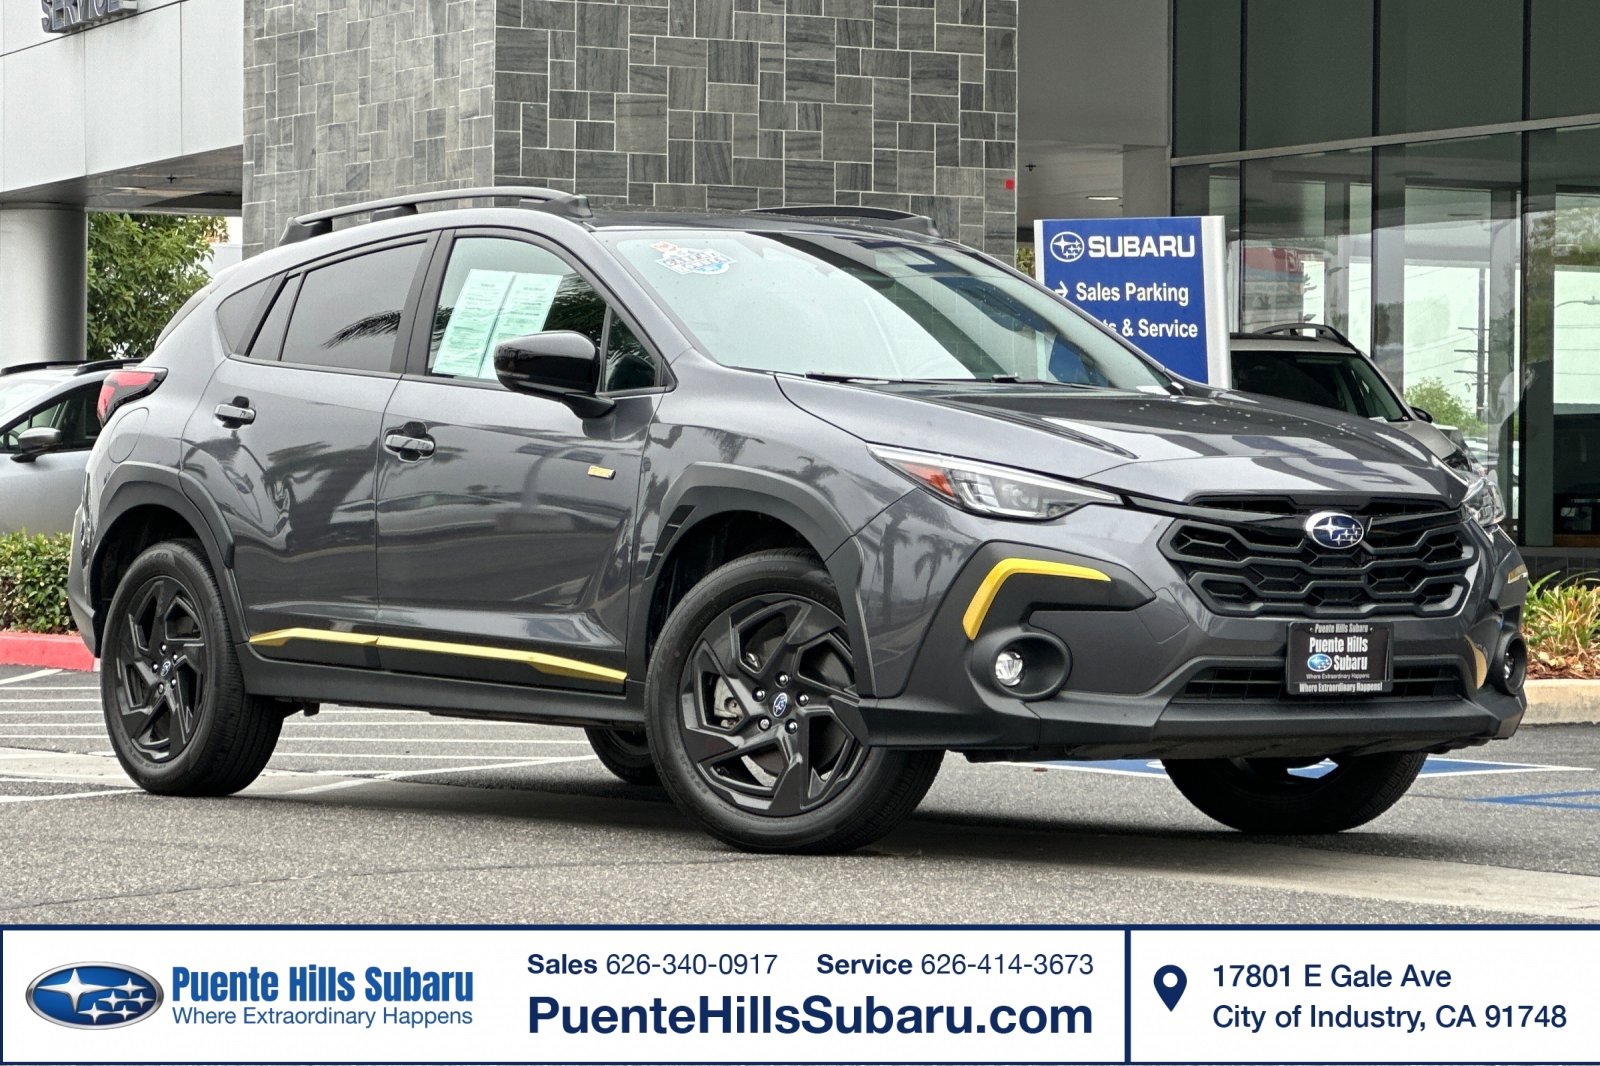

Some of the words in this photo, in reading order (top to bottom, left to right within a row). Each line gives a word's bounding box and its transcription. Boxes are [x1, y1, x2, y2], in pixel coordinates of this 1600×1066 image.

[1088, 235, 1196, 258] SUBARU
[1076, 281, 1121, 301] Sales
[1125, 282, 1189, 306] Parking
[1122, 318, 1134, 337] &
[1138, 318, 1198, 337] Service
[1315, 623, 1335, 633] Puente
[1336, 623, 1348, 633] Hills
[1349, 623, 1369, 633] Subaru
[1309, 637, 1344, 653] Puente
[1347, 636, 1368, 652] Hills
[1334, 655, 1368, 671] Subaru
[1299, 683, 1318, 693] Where
[1318, 683, 1356, 692] Extraordinary
[1356, 681, 1383, 692] Happens!
